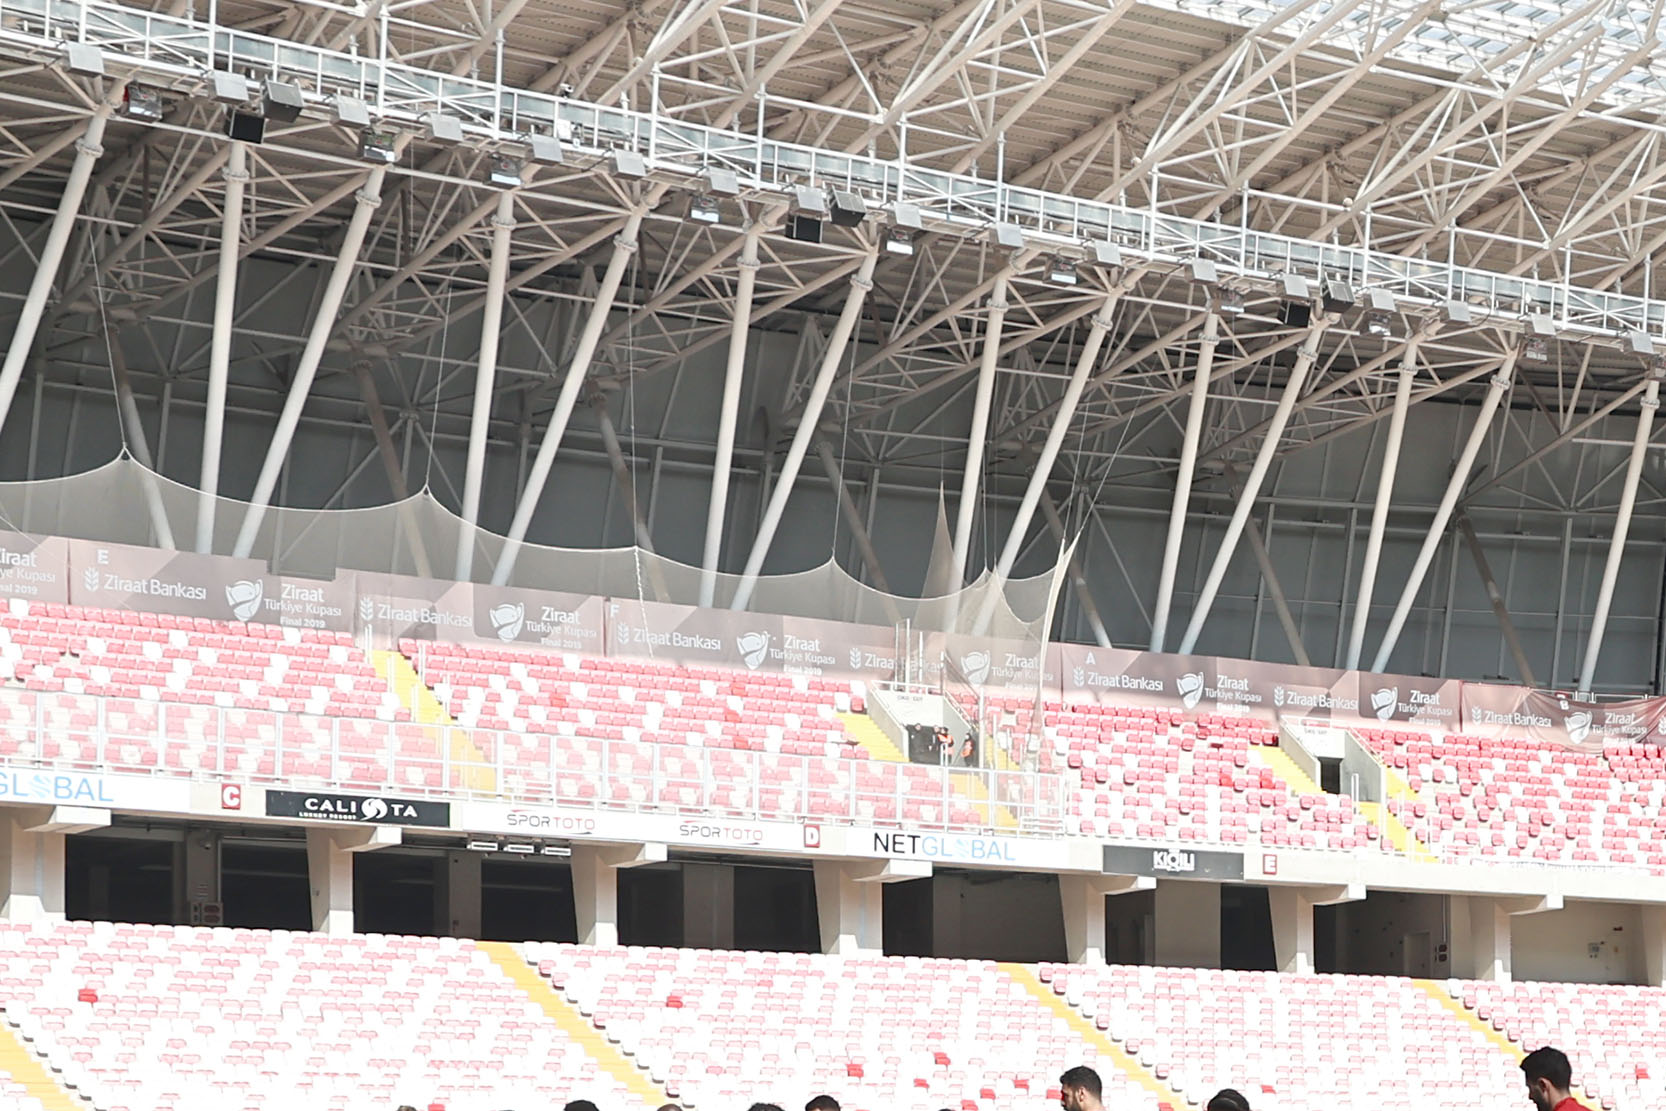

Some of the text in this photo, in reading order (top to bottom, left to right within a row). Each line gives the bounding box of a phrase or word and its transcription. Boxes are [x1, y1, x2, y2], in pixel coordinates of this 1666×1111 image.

[97, 550, 109, 564] E
[104, 574, 207, 600] Ziraat Bankası
[281, 584, 324, 602] Ziraat
[377, 604, 417, 622] Ziraat
[541, 606, 581, 625] Ziraat
[610, 604, 620, 618] F
[672, 633, 721, 651] Bankası
[783, 634, 821, 652] Ziraat
[864, 653, 895, 669] Ziraa
[1086, 651, 1096, 665] A
[1088, 672, 1163, 691] Ziraat Bankası
[1217, 675, 1249, 691] Ziraat
[1287, 691, 1358, 710] Ziraat Bankası
[1410, 690, 1440, 705] Ziraat
[1485, 711, 1551, 728] Ziraat Bankası
[1605, 713, 1635, 724] Ziraat
[223, 786, 240, 806] C
[807, 827, 818, 845] D
[1264, 855, 1277, 873] E
